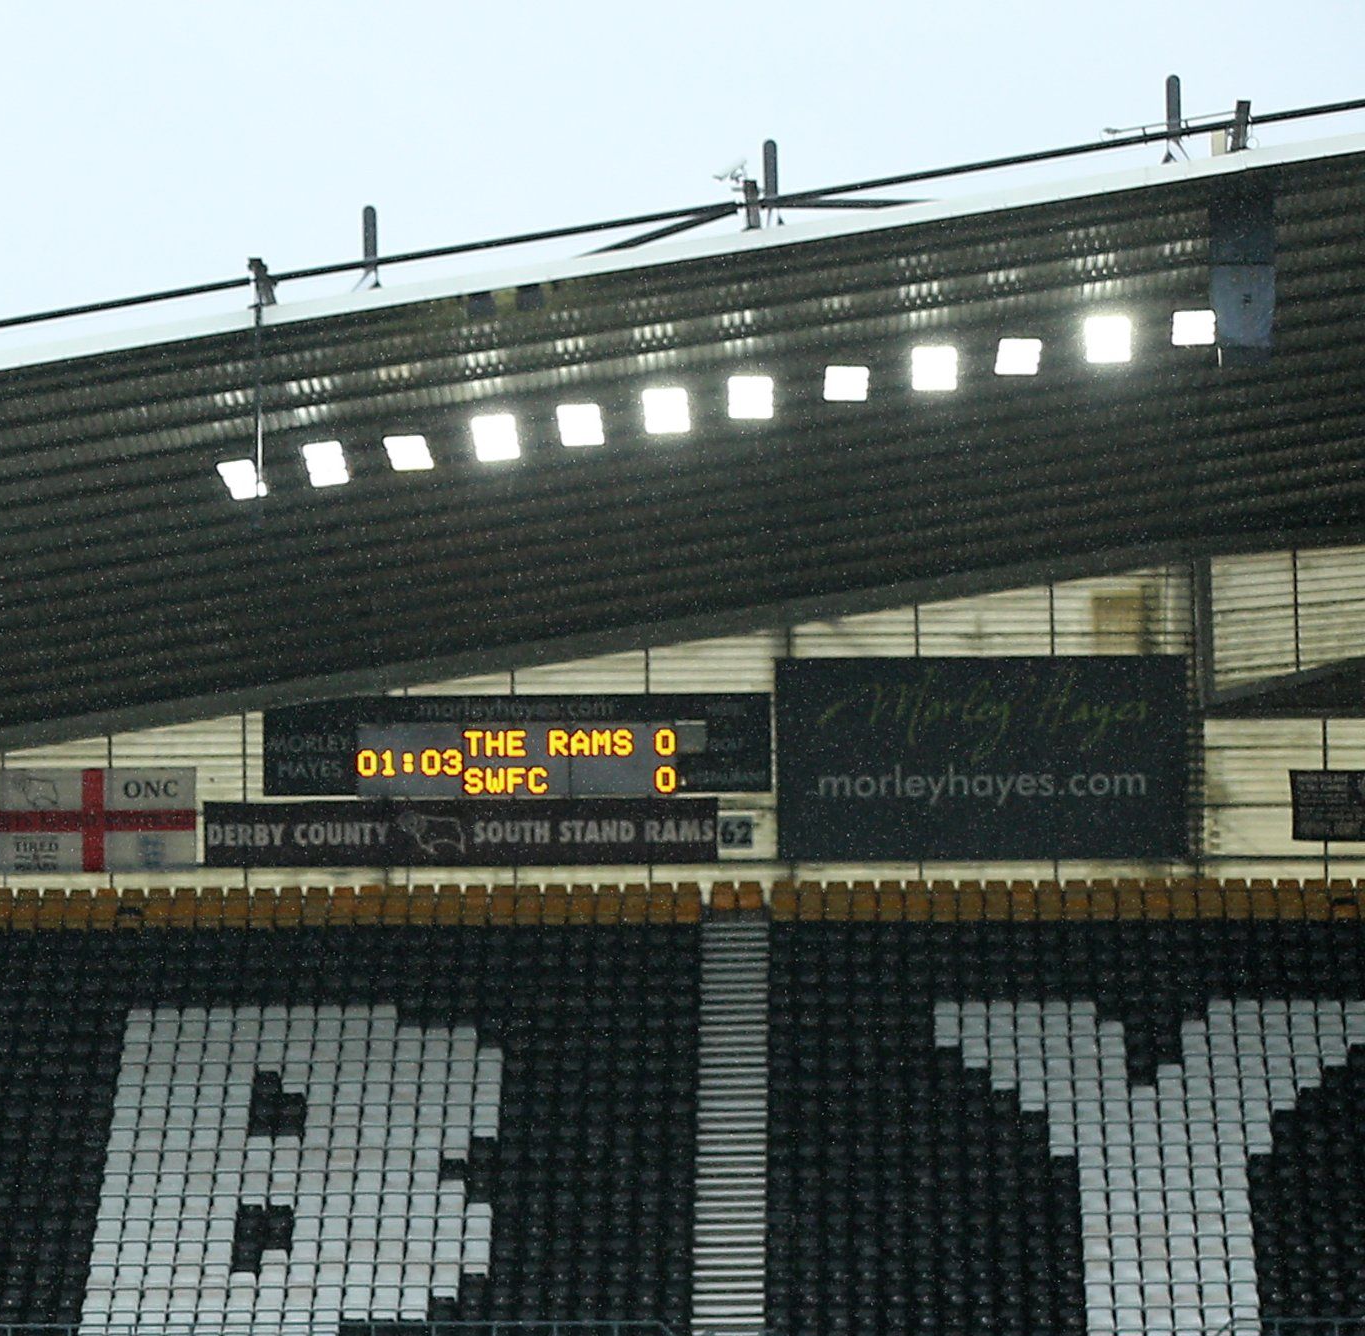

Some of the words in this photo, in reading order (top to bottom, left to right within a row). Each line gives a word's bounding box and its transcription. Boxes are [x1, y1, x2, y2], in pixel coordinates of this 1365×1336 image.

[463, 729, 526, 757] THE
[548, 729, 633, 756] RAMS
[654, 729, 676, 756] 0
[357, 749, 463, 776] 01:03
[123, 780, 180, 799] ONC
[463, 767, 548, 794] SWFC
[654, 766, 676, 793] 0
[819, 765, 1146, 805] morleyhayes.com
[208, 822, 284, 847] DERBY
[294, 821, 390, 845] COUNTY
[474, 820, 550, 844] SOUTH
[559, 820, 635, 843] STAND
[644, 819, 715, 843] RAMS
[721, 820, 752, 845] 62
